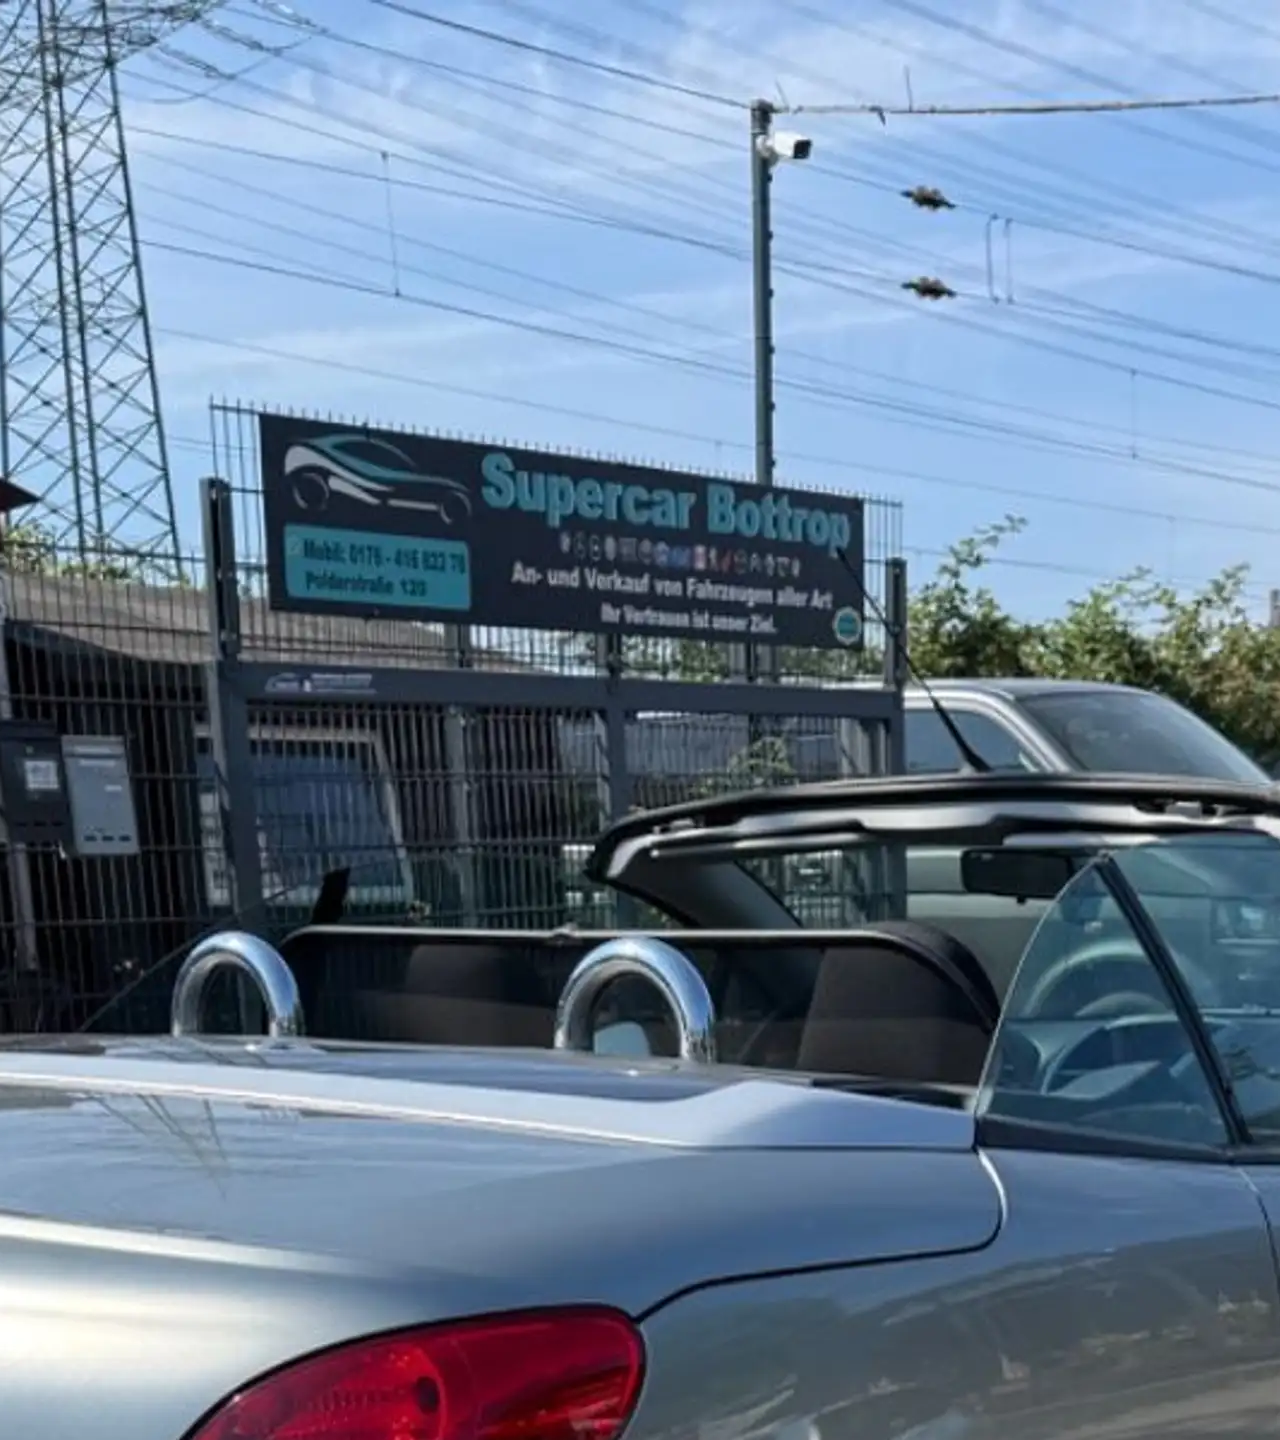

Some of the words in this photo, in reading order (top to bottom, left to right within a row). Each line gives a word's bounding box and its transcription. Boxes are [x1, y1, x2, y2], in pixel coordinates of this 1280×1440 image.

[481, 452, 697, 529] Supercar
[707, 483, 851, 559] Bottrop
[511, 561, 544, 584] An-
[547, 567, 579, 588] und
[583, 567, 650, 594] Verkauf
[654, 577, 683, 597] von
[685, 577, 773, 608] Fahrzeugen
